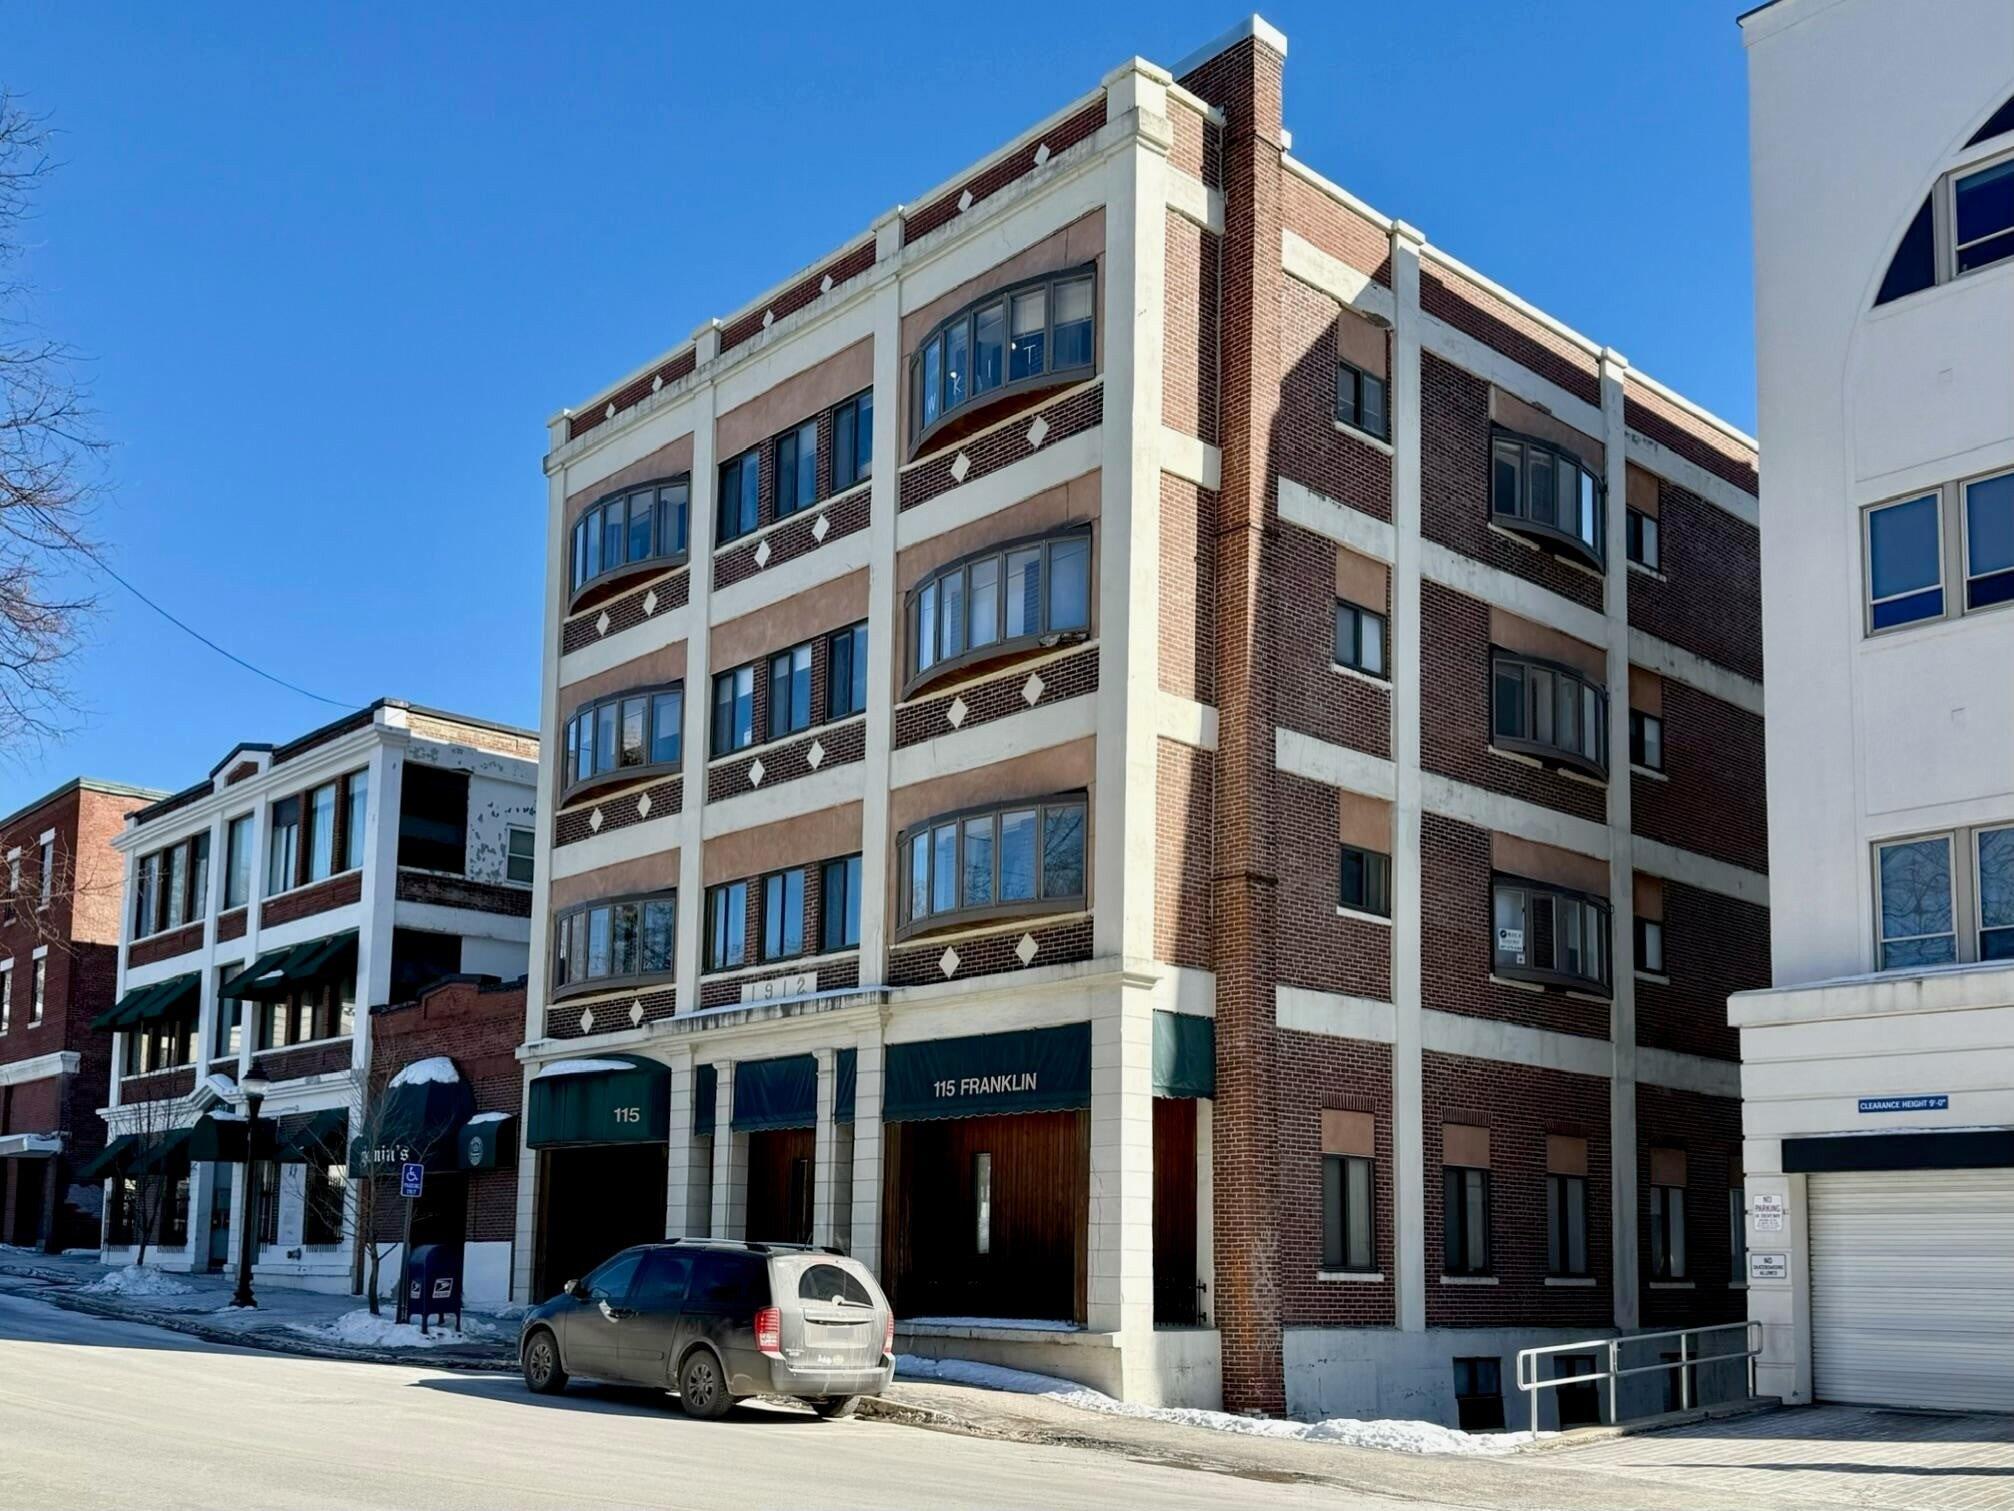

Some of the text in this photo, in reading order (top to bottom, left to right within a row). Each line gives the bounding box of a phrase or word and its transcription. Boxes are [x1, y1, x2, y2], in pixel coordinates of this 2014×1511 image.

[752, 976, 807, 1002] 1912
[934, 1072, 1037, 1098] 115 FRANKLIN
[1860, 1101, 1900, 1110] CLEARANCE
[1902, 1100, 1927, 1109] HEIGHT
[613, 1107, 640, 1123] 115
[1755, 1204, 1781, 1212] PARKING
